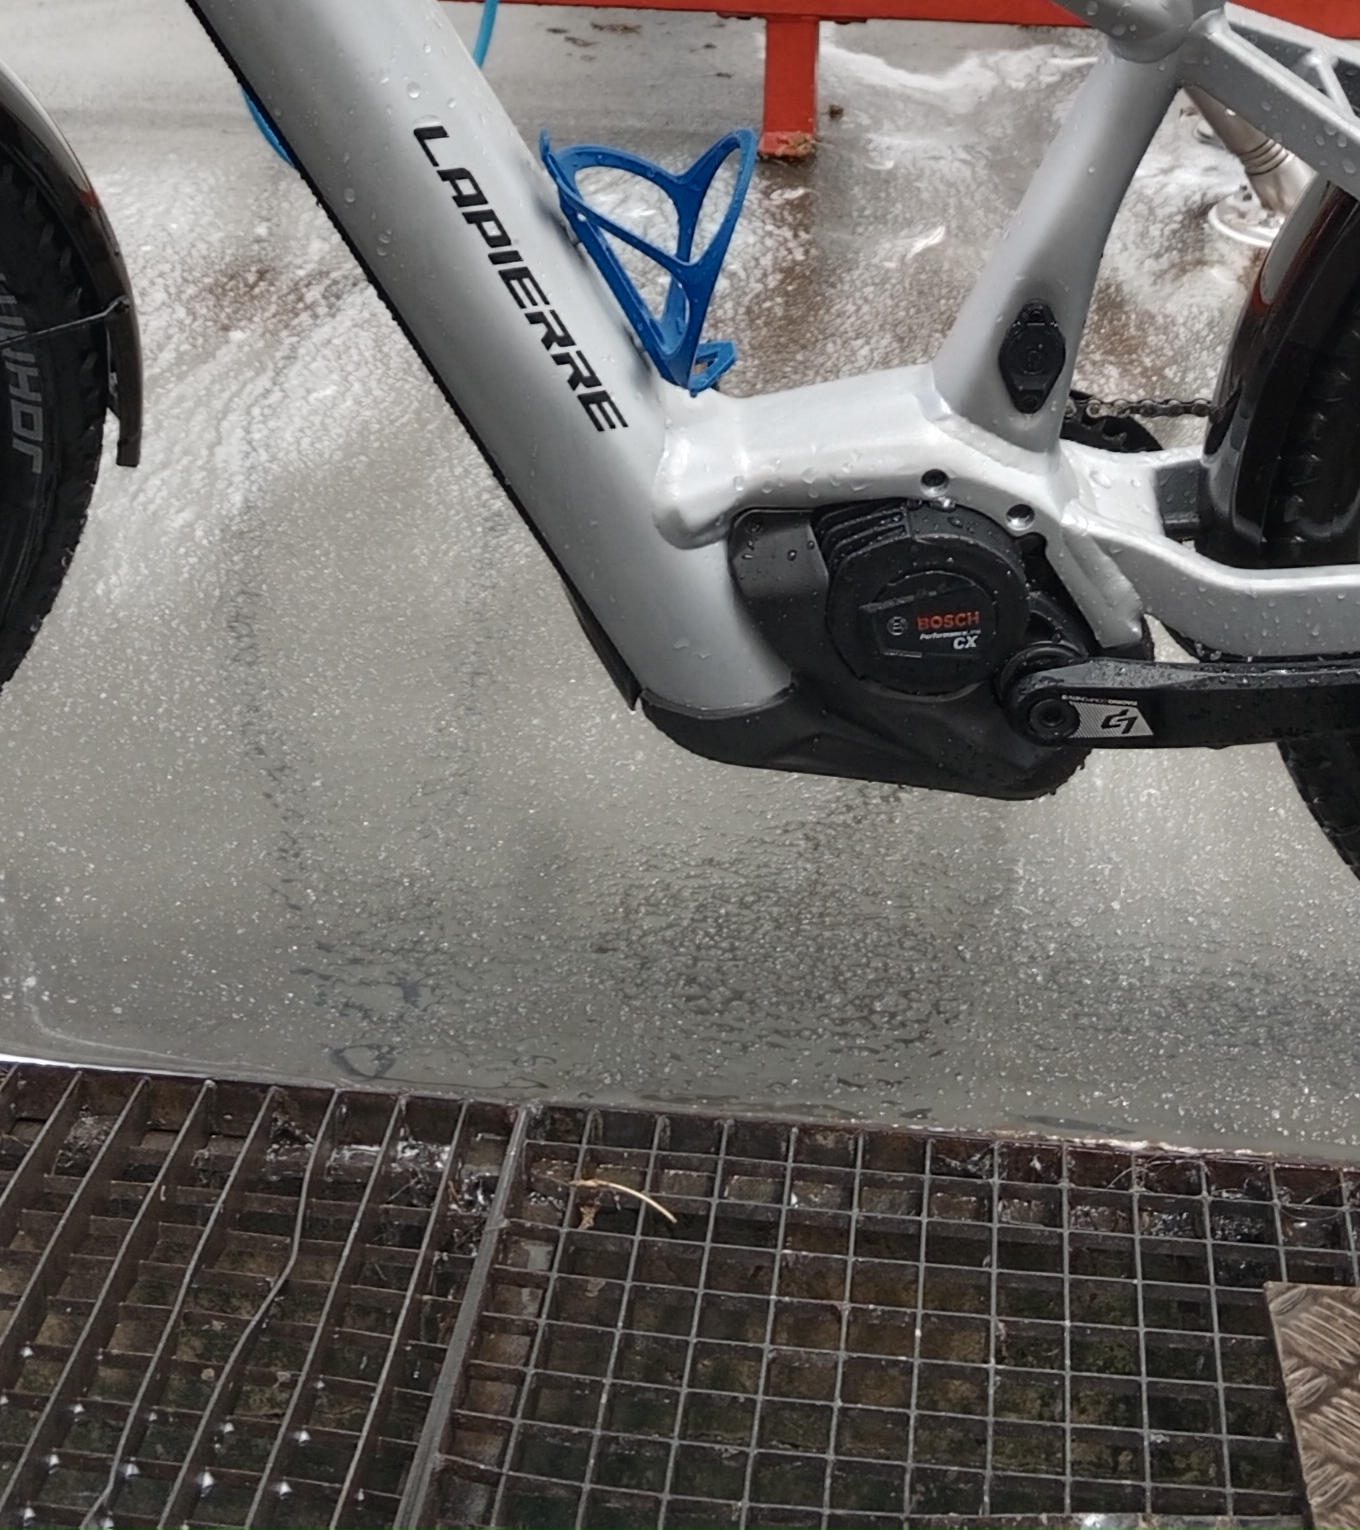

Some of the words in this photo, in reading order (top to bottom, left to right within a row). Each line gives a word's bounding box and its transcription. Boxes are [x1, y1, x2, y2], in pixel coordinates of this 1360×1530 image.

[414, 125, 629, 432] LAPIERRE
[917, 611, 979, 630] BOSCH
[953, 635, 978, 650] CX
